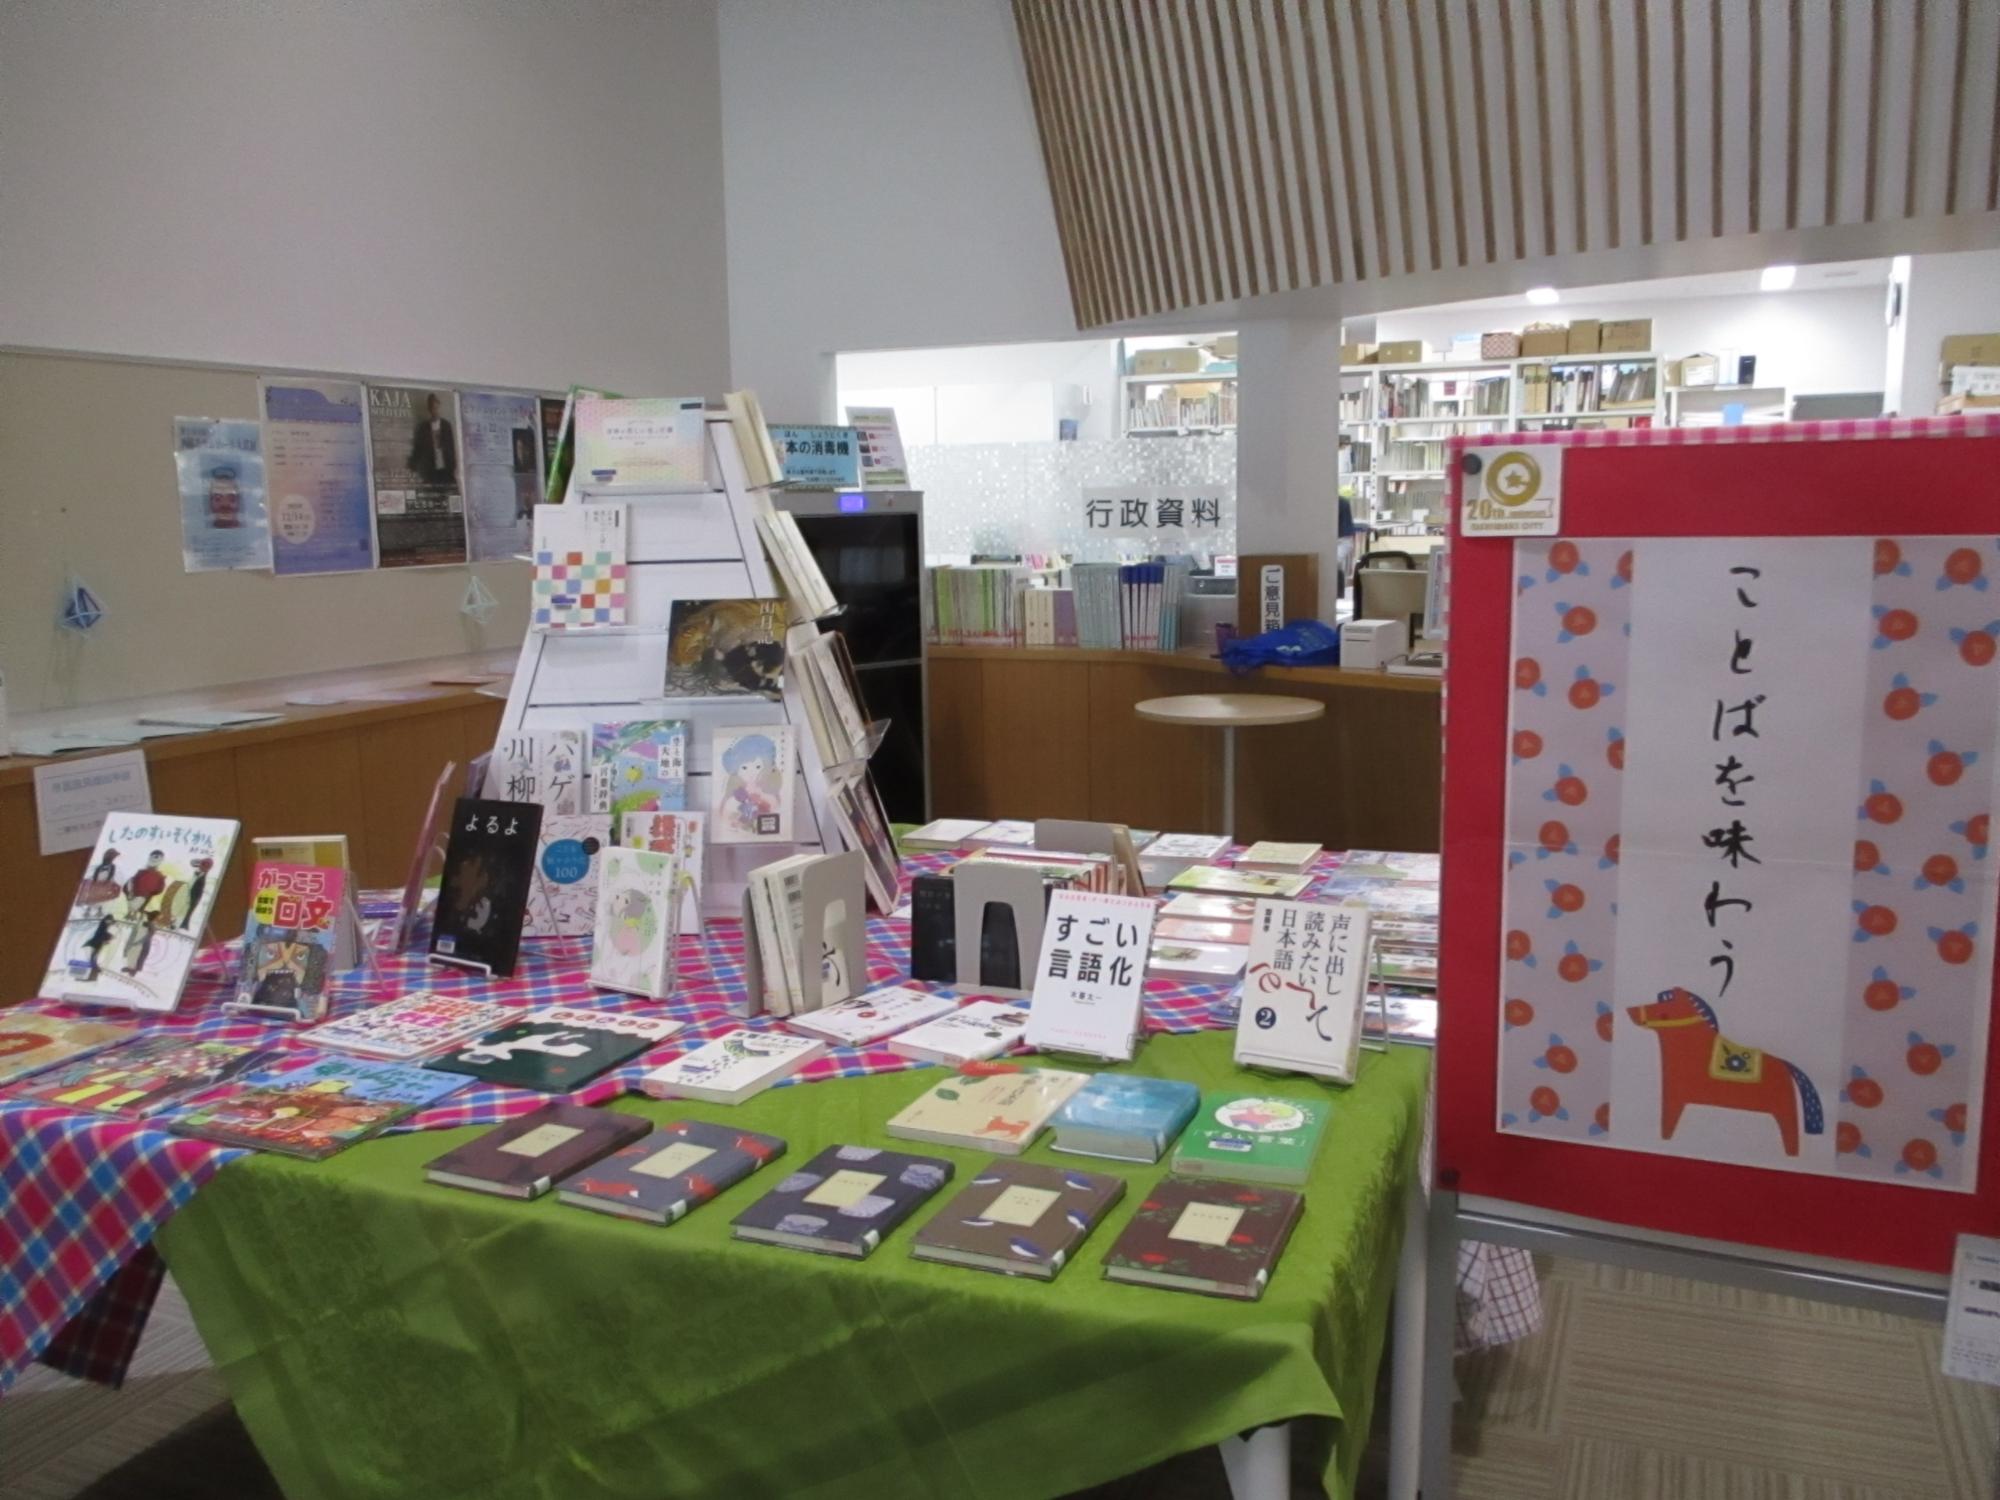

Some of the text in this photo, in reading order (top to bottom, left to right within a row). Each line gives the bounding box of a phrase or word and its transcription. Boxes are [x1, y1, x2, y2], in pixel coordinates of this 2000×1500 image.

[370, 389, 412, 408] KAJA
[785, 440, 849, 456] 本の消毒機
[1086, 498, 1221, 528] 行政資料
[506, 737, 535, 801] 川柳
[548, 745, 575, 800] ハゲ
[1702, 565, 1765, 998] ことばを味わう
[465, 813, 519, 836] よるよ
[257, 868, 325, 895] がっこう
[556, 867, 578, 879] 100
[272, 895, 334, 930] 回文
[1057, 914, 1137, 948] すごい
[1273, 909, 1297, 971] 日本語
[1298, 911, 1326, 987] 読みたい
[1048, 948, 1133, 987] 言語化
